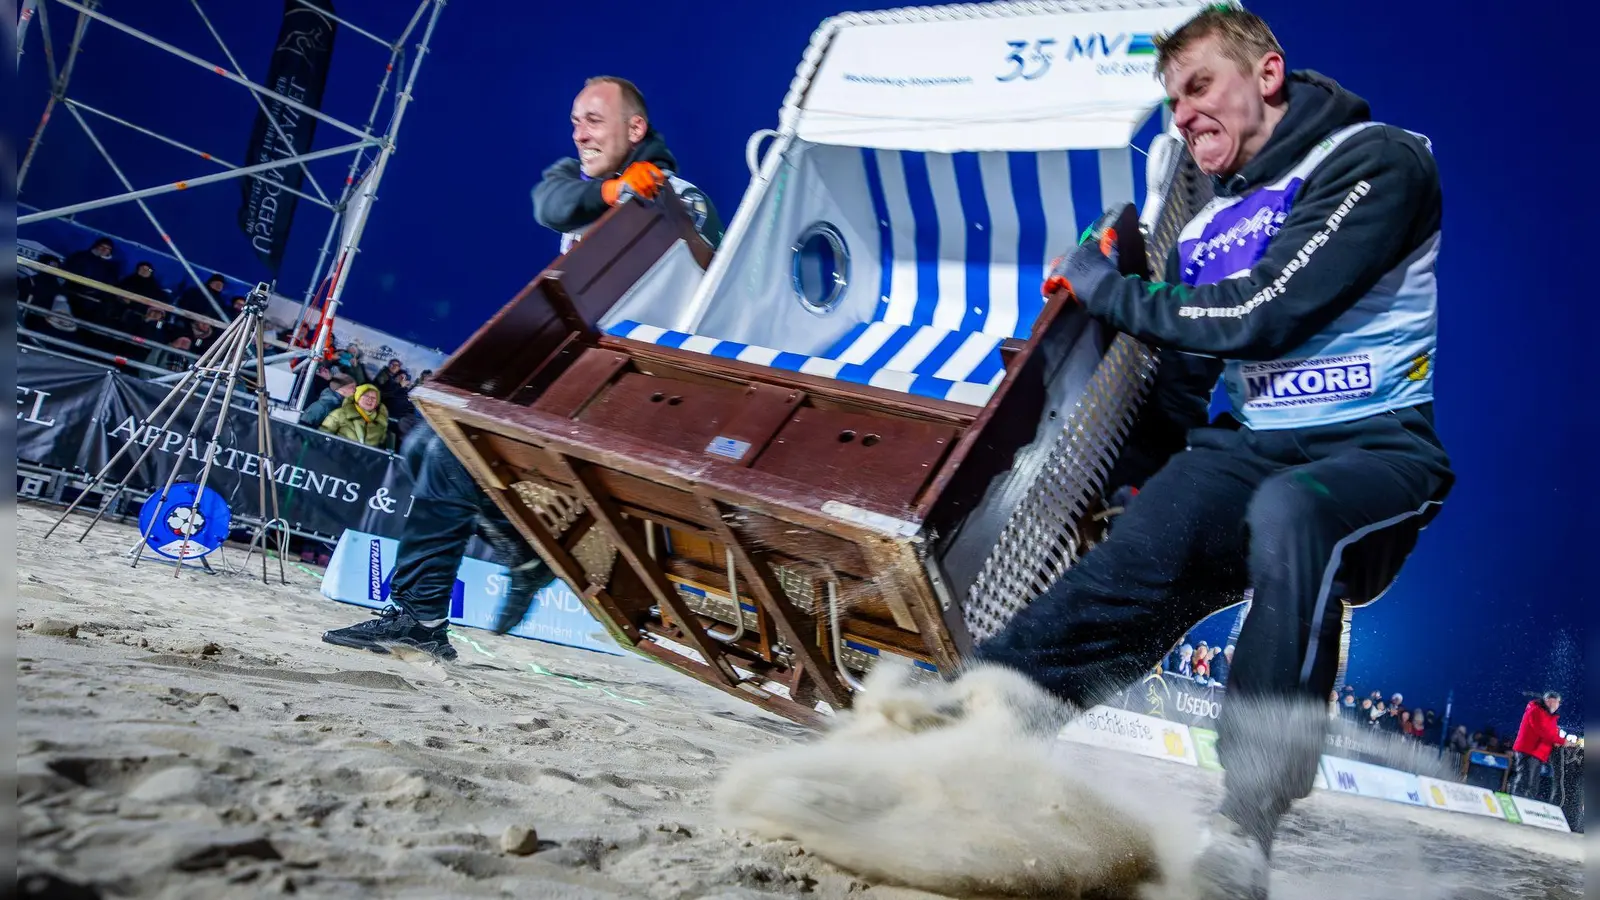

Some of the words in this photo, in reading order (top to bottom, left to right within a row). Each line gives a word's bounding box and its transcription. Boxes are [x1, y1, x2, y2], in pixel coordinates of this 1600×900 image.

[995, 38, 1058, 82] 35
[1065, 32, 1126, 62] MV
[1273, 365, 1370, 396] KORB
[107, 415, 361, 502] APPARTEMENTS
[368, 486, 397, 514] &
[371, 540, 381, 600] STRANDKORB
[1176, 691, 1222, 719] USEDO
